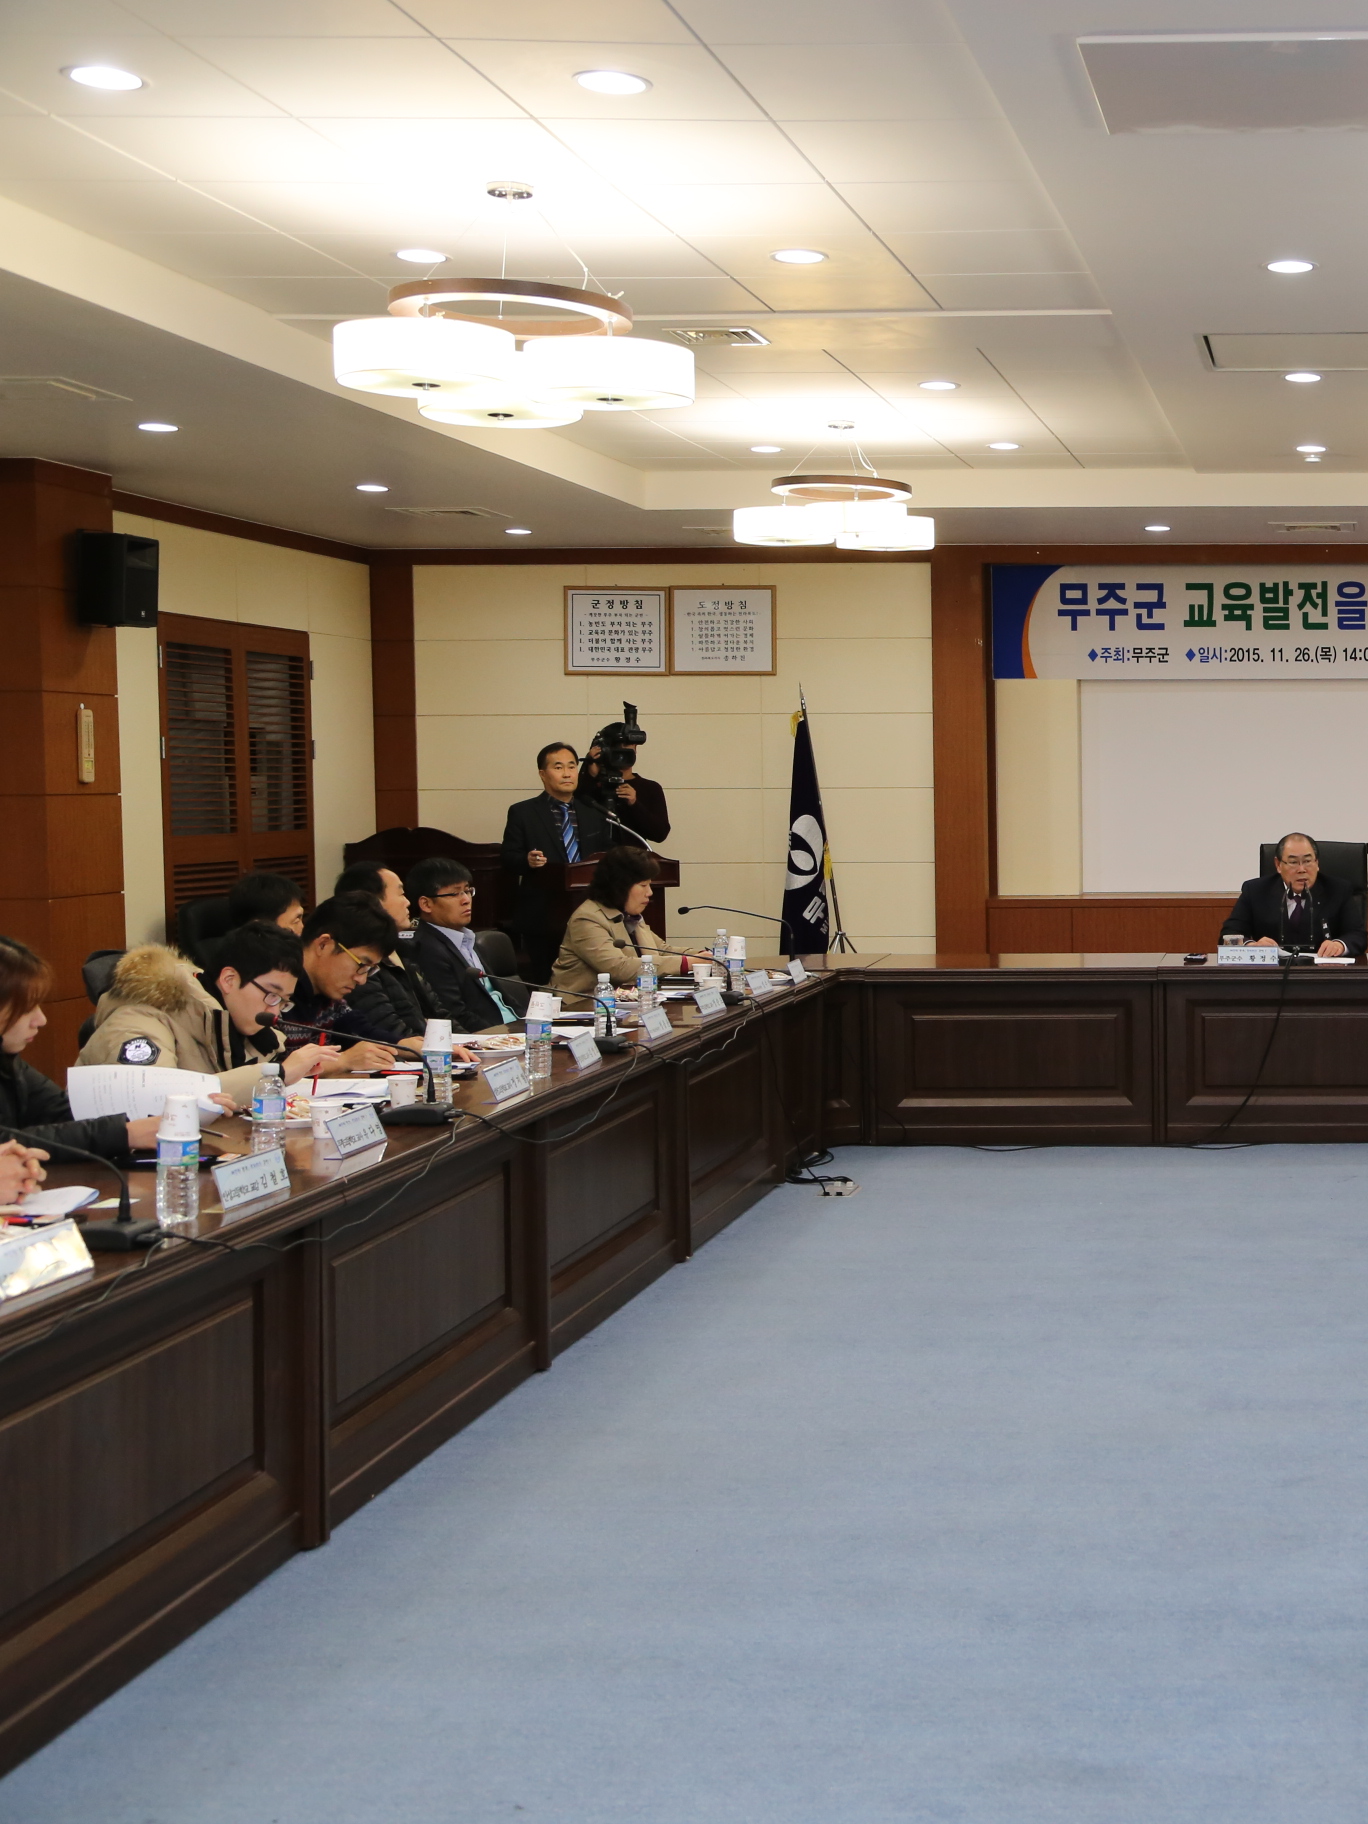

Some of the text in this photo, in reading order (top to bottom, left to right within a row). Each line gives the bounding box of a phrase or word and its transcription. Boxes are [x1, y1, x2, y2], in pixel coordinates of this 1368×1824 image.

[1057, 581, 1168, 631] 무주군
[1183, 579, 1368, 631] 교육발전을
[1270, 647, 1290, 663] 11.
